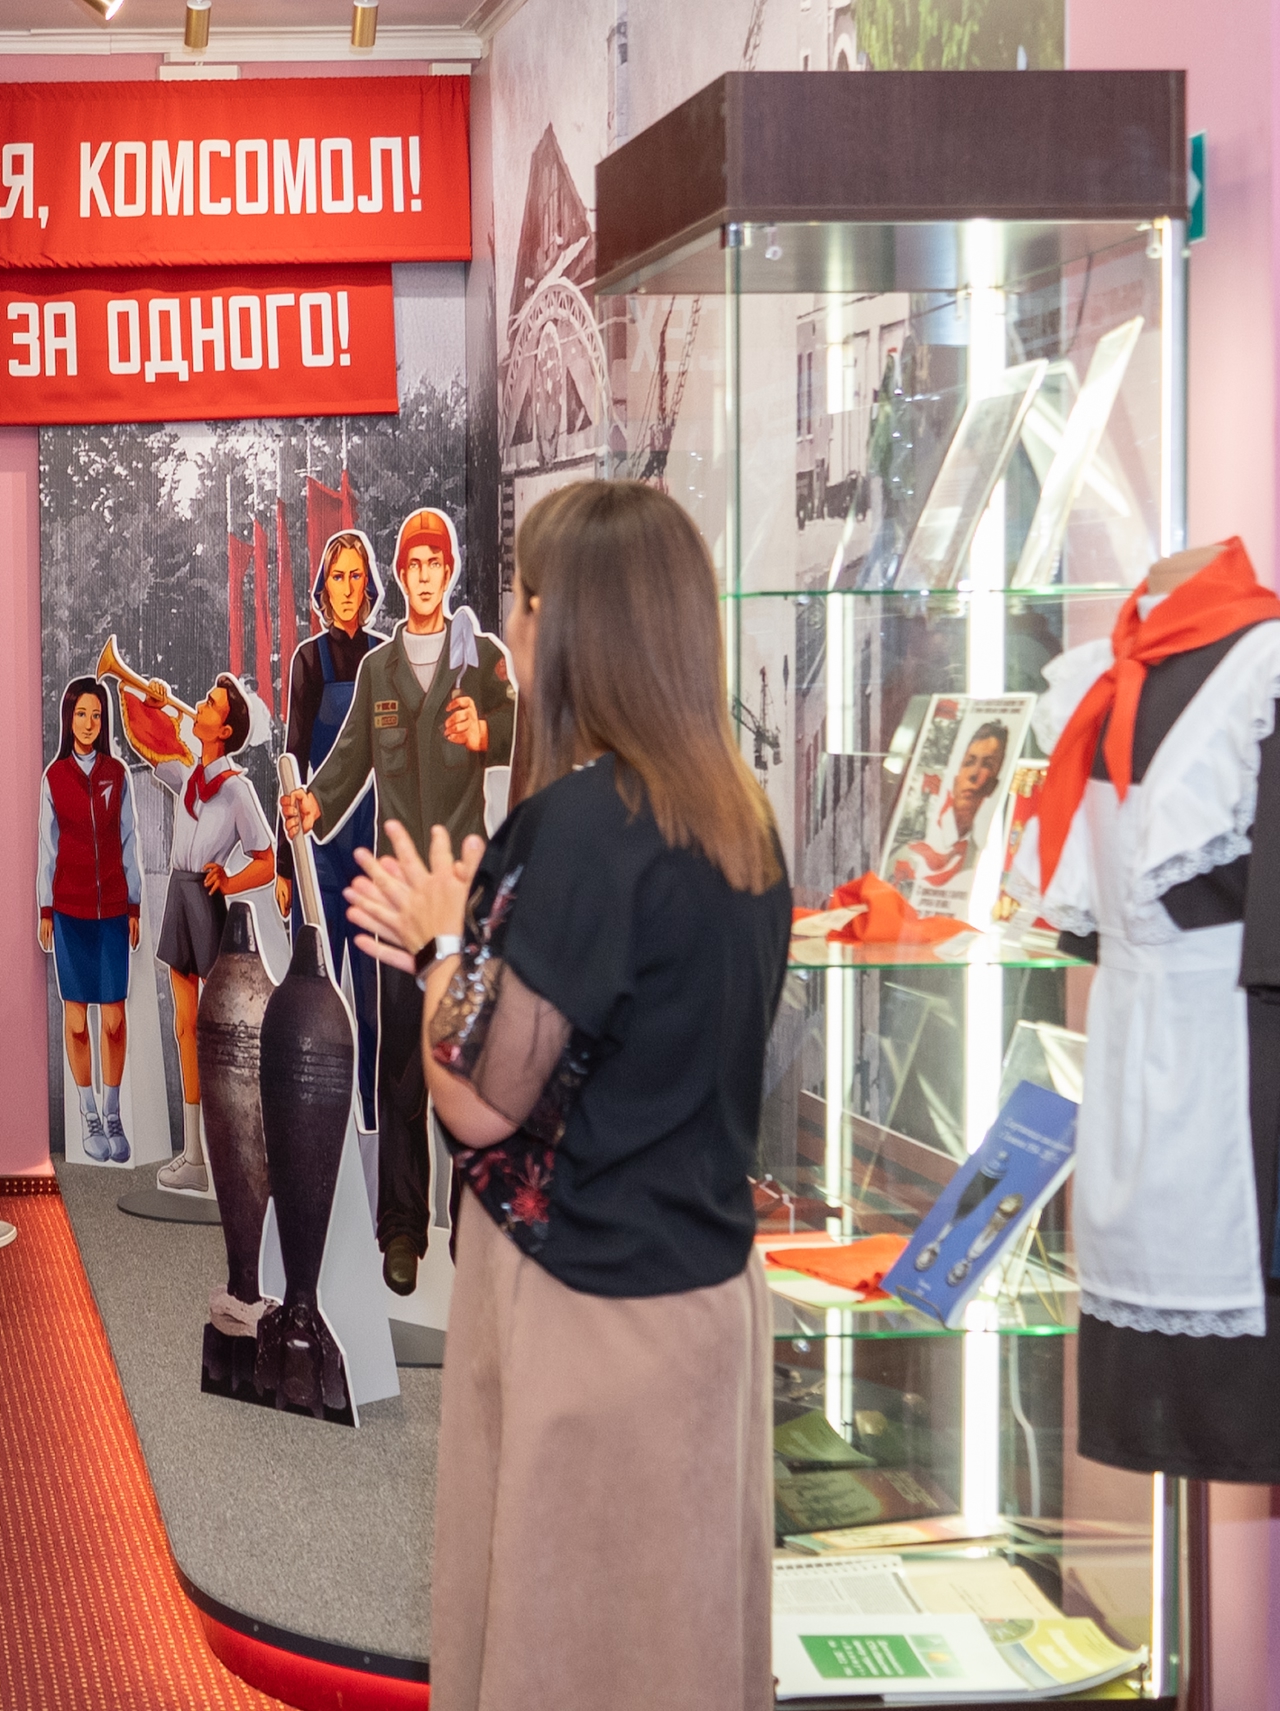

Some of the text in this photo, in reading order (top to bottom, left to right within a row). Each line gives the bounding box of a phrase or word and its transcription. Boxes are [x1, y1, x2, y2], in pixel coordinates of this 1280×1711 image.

[79, 135, 423, 218] КОМСОМОЛ!
[6, 300, 78, 377] ЗА
[106, 290, 351, 383] ОДНОГО!
